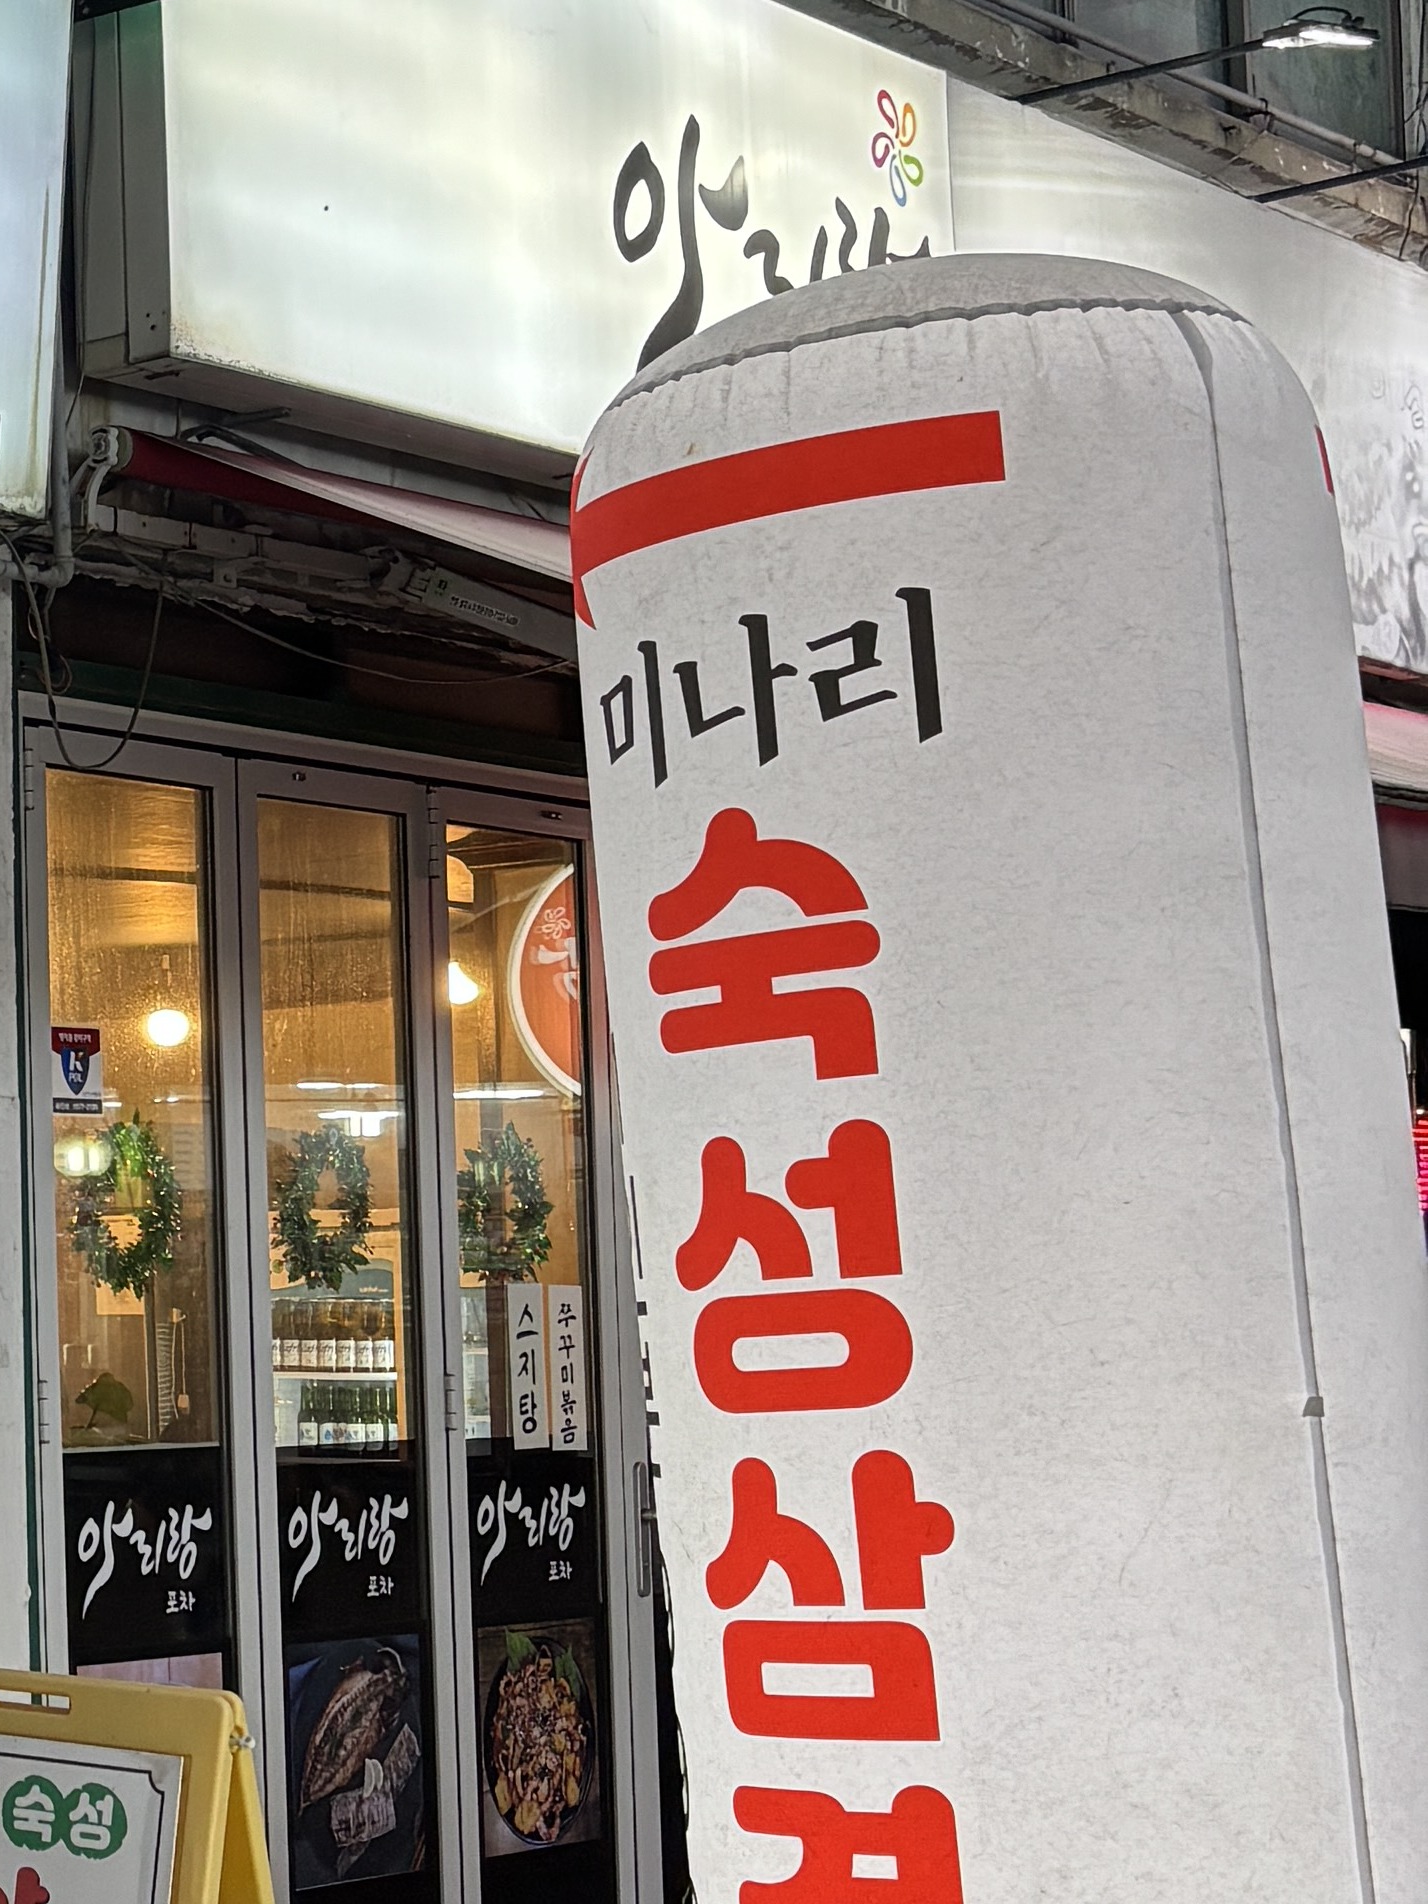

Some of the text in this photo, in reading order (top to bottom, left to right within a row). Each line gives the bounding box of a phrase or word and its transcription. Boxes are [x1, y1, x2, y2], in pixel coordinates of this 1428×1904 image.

[599, 585, 944, 789] 미나리
[516, 1303, 540, 1436] 스지탕
[77, 1499, 212, 1620] 아리랑
[288, 1490, 408, 1602] 아리랑
[366, 1575, 394, 1597] 포차
[477, 1480, 586, 1586] 아리랑
[548, 1559, 572, 1582] 포차
[165, 1589, 197, 1614] 포차
[12, 1788, 117, 1853] 숙성
